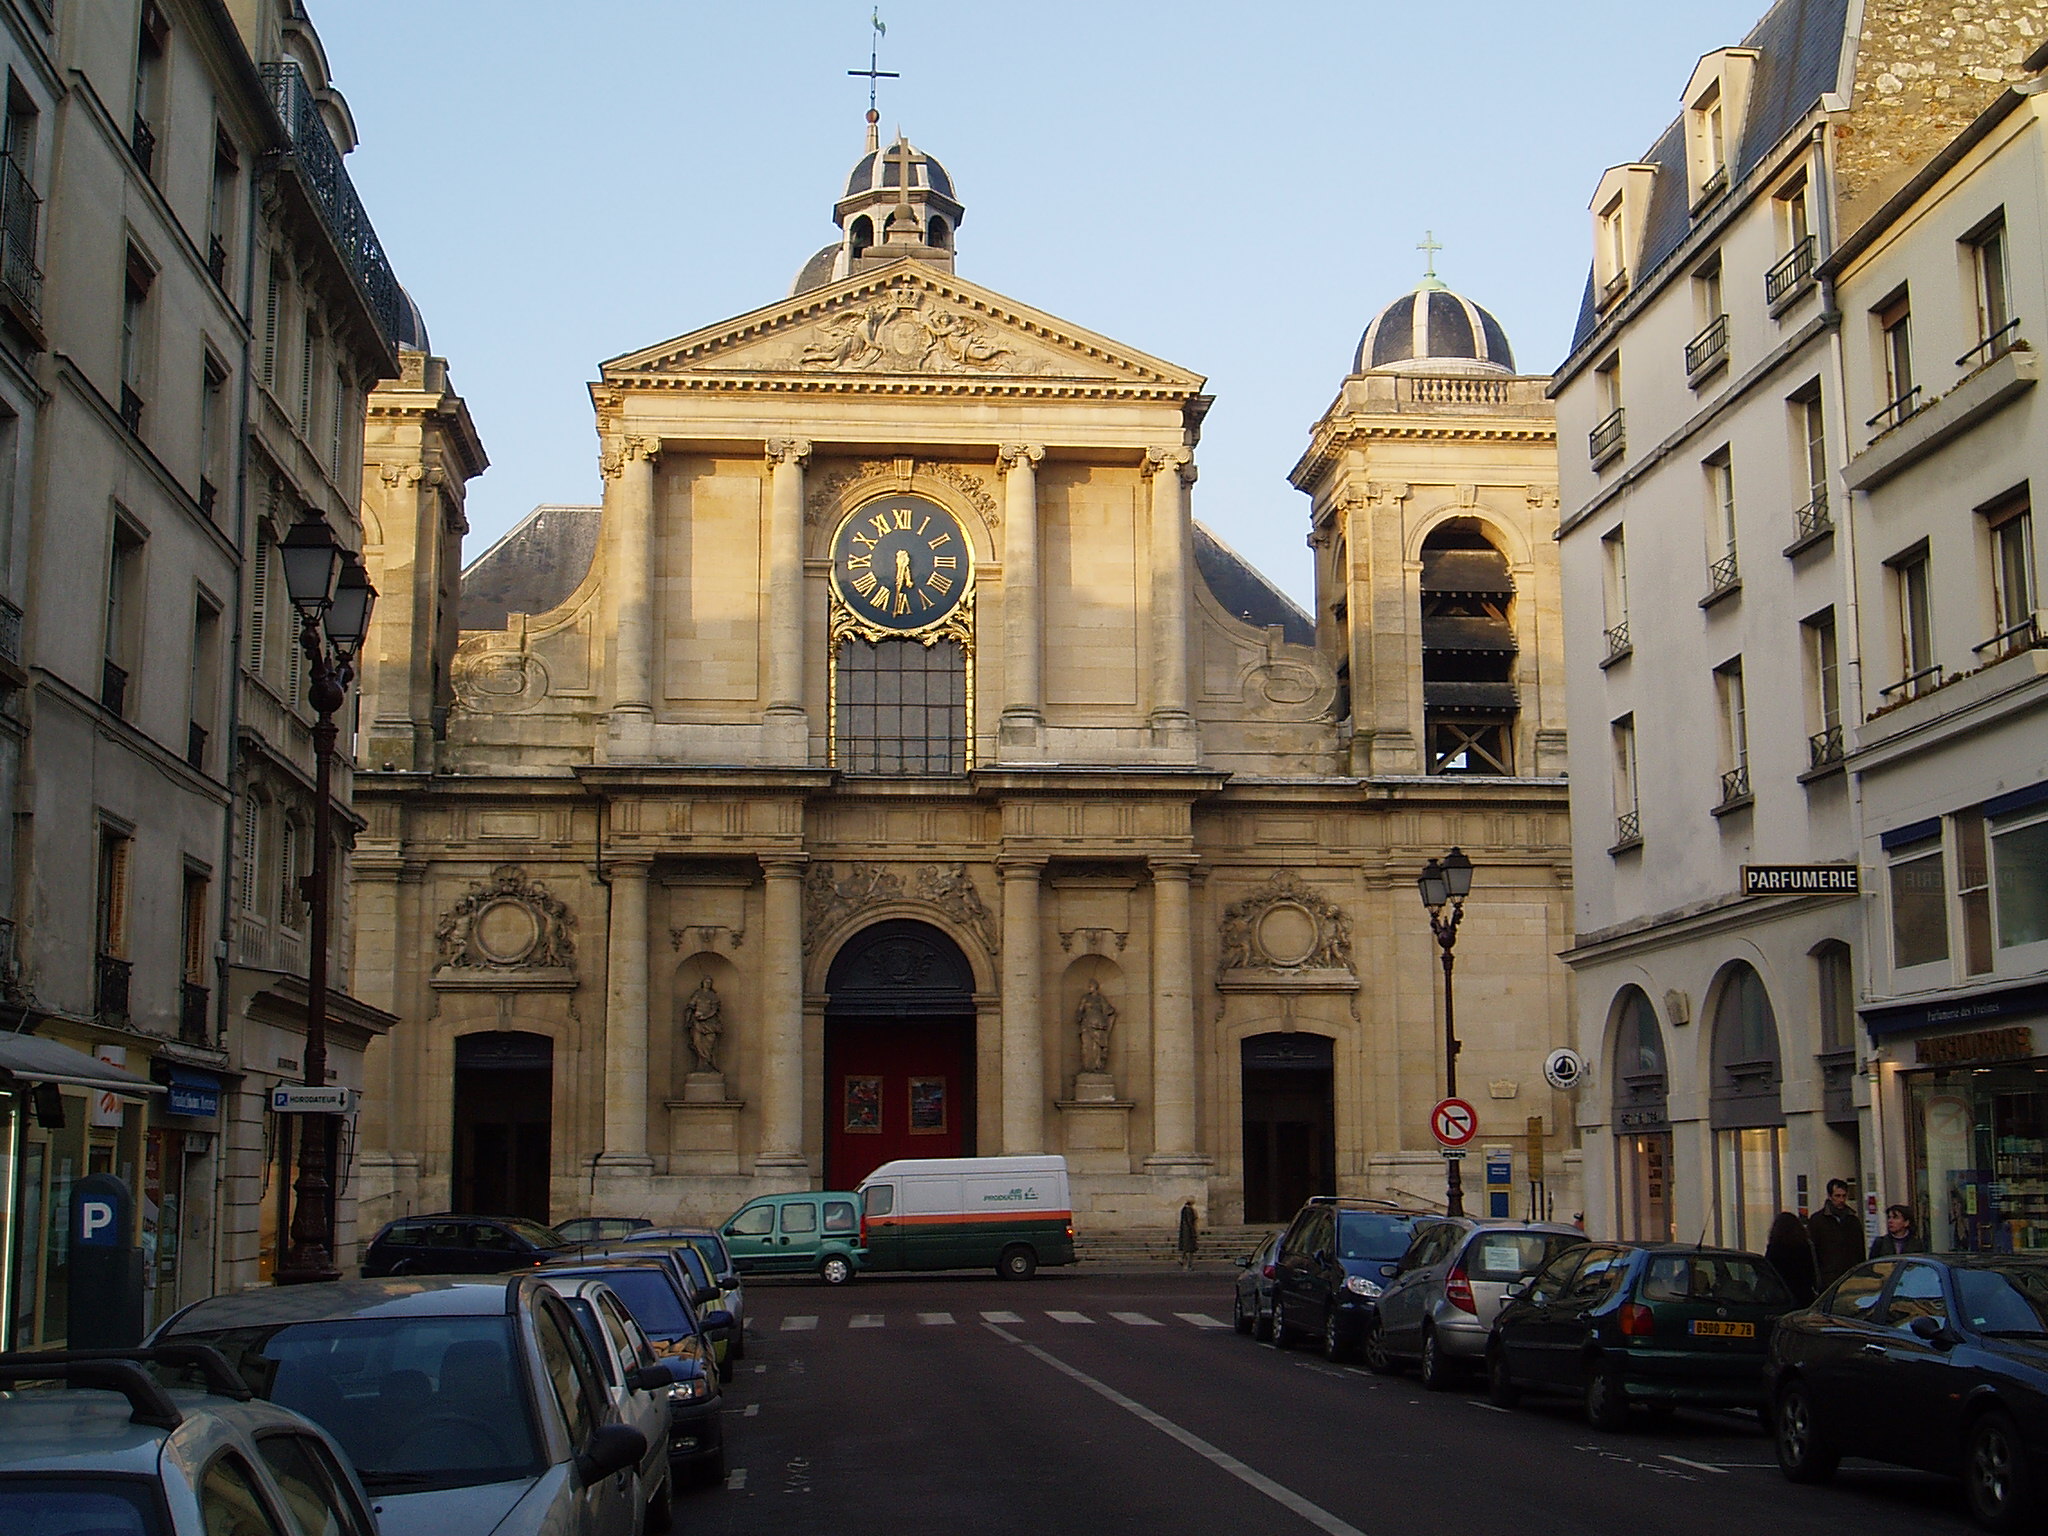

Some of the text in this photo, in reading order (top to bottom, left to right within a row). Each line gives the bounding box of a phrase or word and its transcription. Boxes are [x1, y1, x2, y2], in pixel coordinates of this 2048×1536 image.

[868, 512, 892, 538] XI
[892, 509, 912, 530] XII
[917, 516, 931, 536] I
[852, 531, 879, 551] X
[928, 532, 952, 550] II
[847, 553, 872, 571] IX
[934, 556, 957, 569] III
[852, 571, 878, 598] VIII
[926, 571, 953, 596] IIII
[869, 585, 891, 612] VII
[917, 588, 936, 611] V
[1747, 870, 1857, 889] PARFUMERIE
[277, 1094, 337, 1105] P HORODATEUR
[83, 1202, 113, 1239] P
[1724, 1323, 1736, 1334] ZP
[1740, 1324, 1752, 1335] 78
